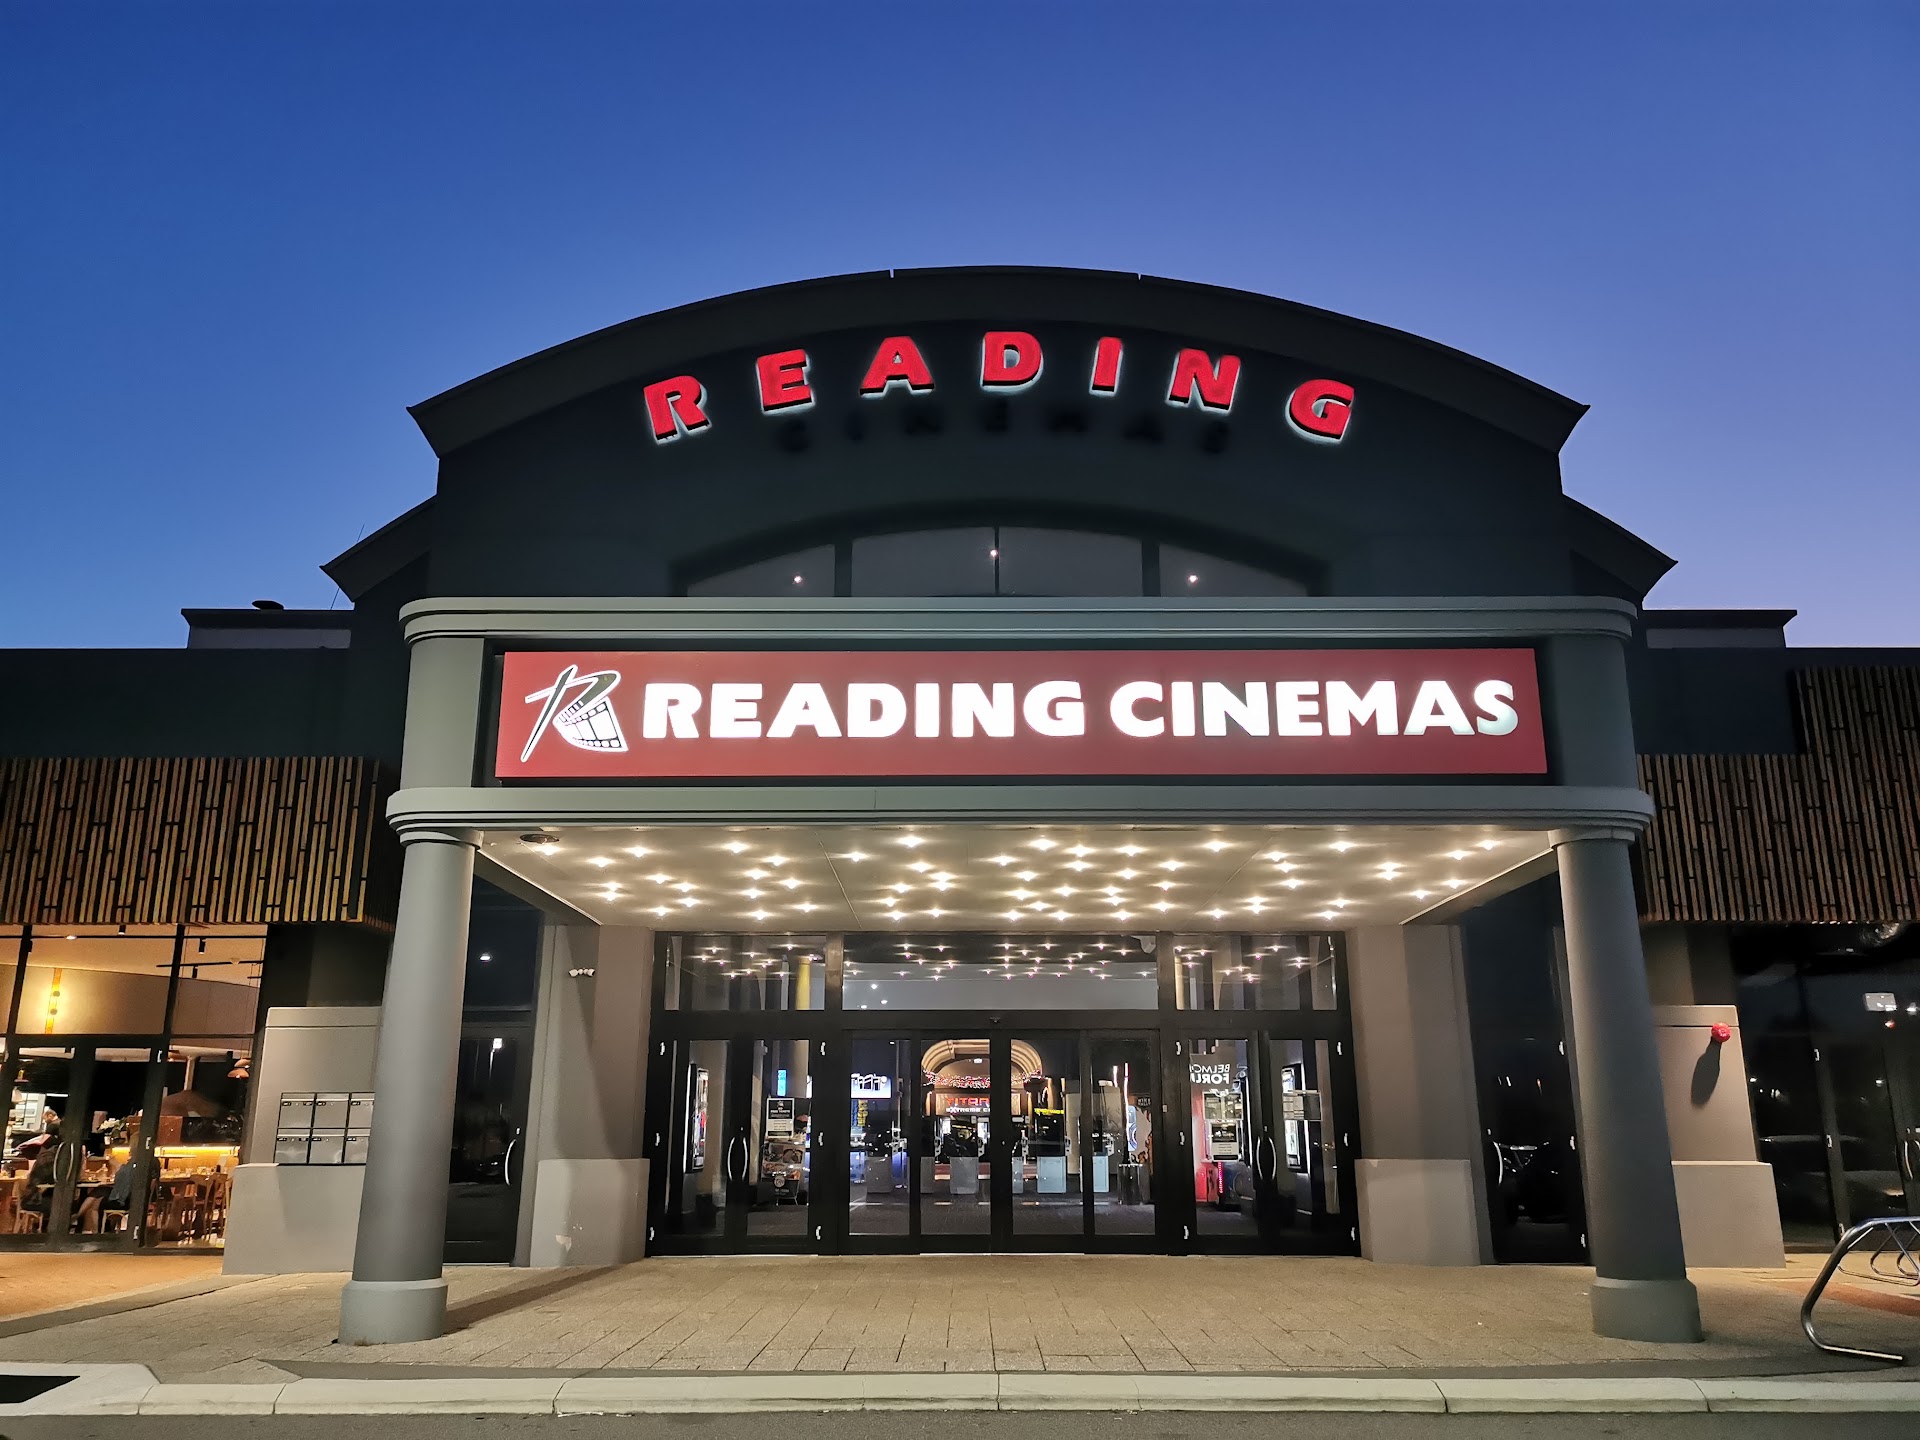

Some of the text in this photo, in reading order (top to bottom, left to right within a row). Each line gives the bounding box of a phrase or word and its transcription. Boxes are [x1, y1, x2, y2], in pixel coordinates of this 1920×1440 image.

[643, 331, 1356, 442] READING
[642, 680, 1085, 738] READING
[1110, 679, 1519, 738] CINEMAS
